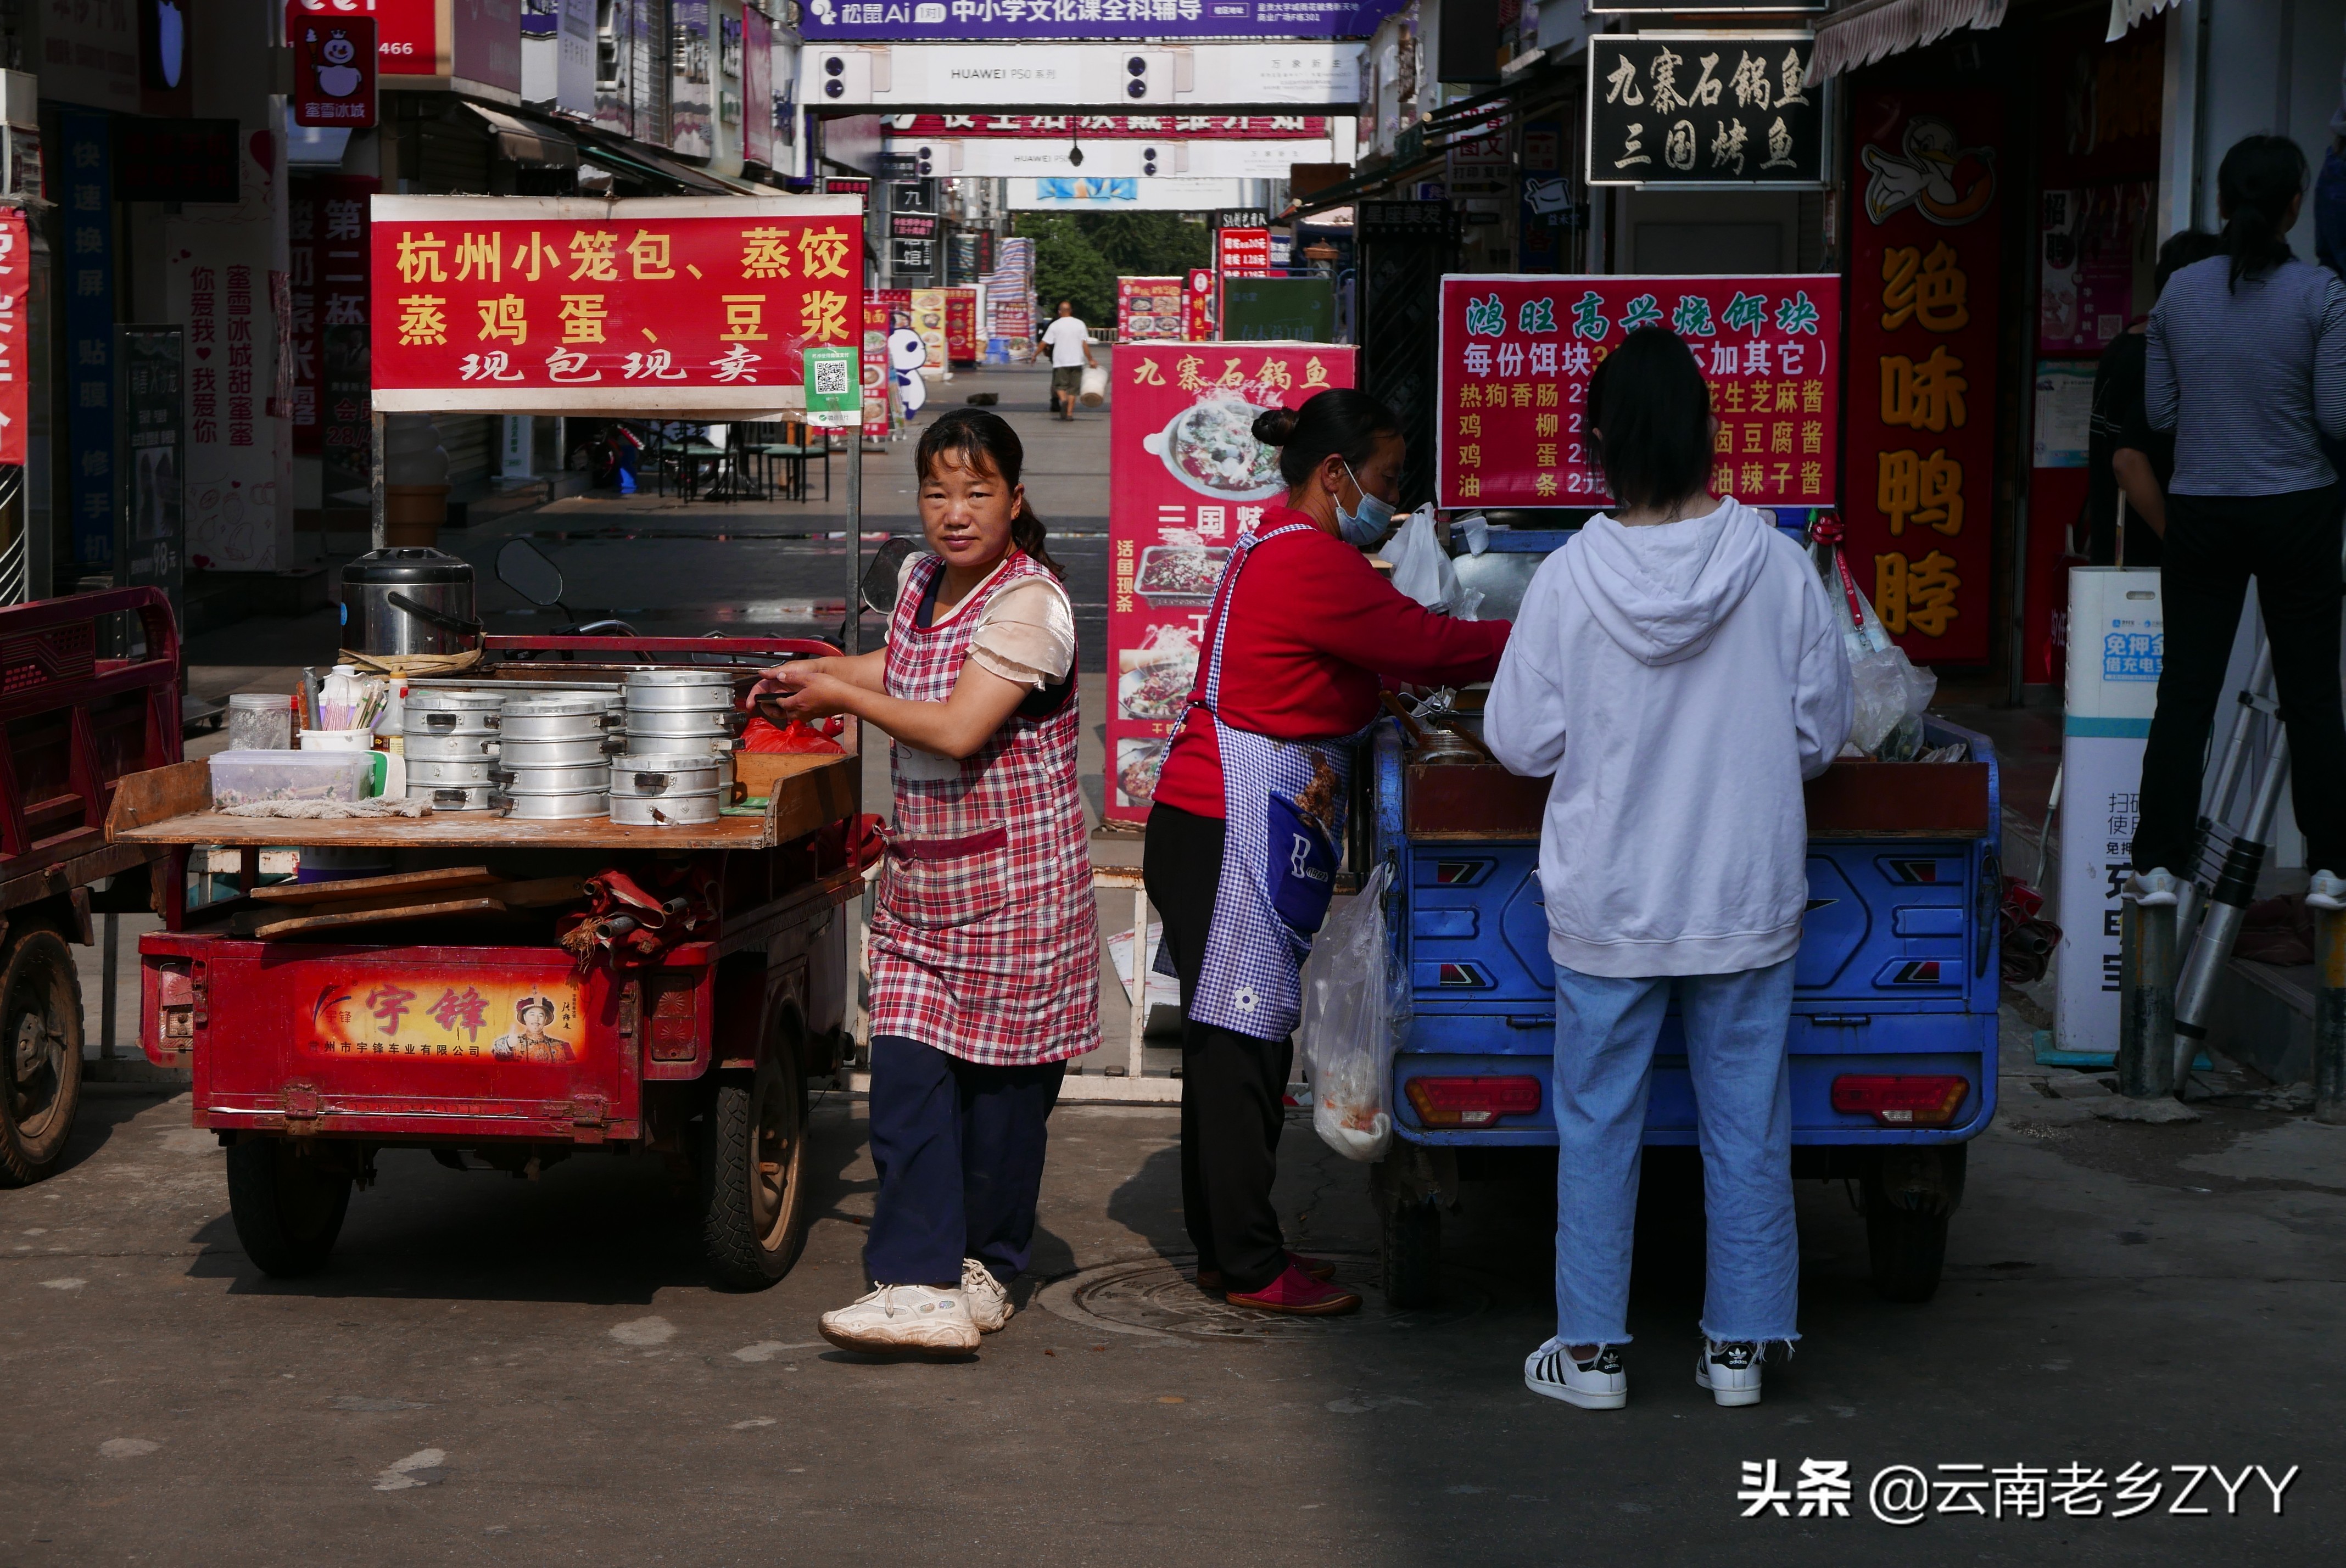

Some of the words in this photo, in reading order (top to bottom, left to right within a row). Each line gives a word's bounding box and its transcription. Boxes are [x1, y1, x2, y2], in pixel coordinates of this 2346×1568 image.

[842, 2, 910, 23] 松鼠Ai
[952, 0, 1202, 23] 中小学文化课全科辅导
[951, 69, 1006, 79] HUAWEI
[1010, 70, 1031, 79] P50
[1606, 45, 1810, 115] 九寨石锅鱼
[305, 102, 366, 118] 蜜雪冰城
[1614, 116, 1797, 176] 三国烤鱼
[71, 140, 105, 297] 快速换屏
[1366, 204, 1442, 224] 星座美发
[191, 266, 215, 343] 你爱我
[1466, 291, 1820, 340] 鸿旺高兴烧饵块
[77, 338, 109, 408] 贴膜
[227, 264, 254, 446] 蜜雪冰城甜蜜蜜
[459, 343, 762, 383] 现包现卖
[1133, 353, 1331, 391] 九寨石锅鱼
[1464, 341, 1617, 378] 每份饵块3
[192, 368, 217, 444] 我爱你
[1459, 382, 1559, 408] 热狗香肠
[1873, 240, 1971, 638] 绝味鸭脖
[80, 449, 111, 561] 修手机
[1116, 539, 1134, 613] 活鱼现杀
[325, 1010, 351, 1023] 宇锋
[365, 983, 490, 1043] 宇锋
[308, 1040, 480, 1058] 常州市宇锋车业有限公司
